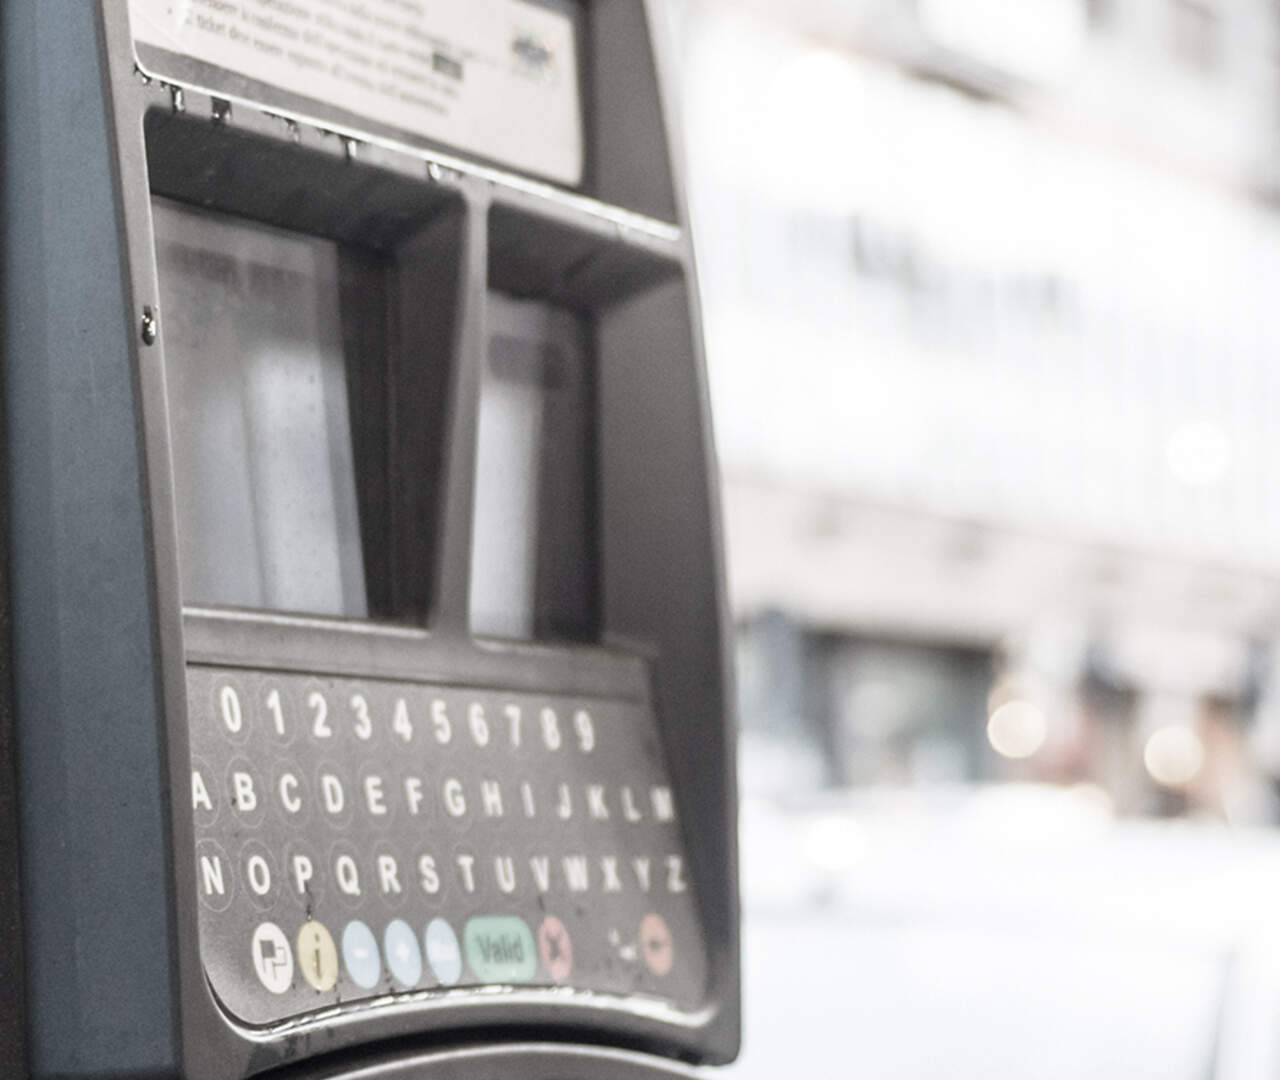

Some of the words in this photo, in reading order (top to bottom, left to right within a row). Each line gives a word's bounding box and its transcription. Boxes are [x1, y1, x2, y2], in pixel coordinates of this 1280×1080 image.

[222, 686, 242, 733] 0
[267, 689, 285, 735] 1
[308, 692, 333, 738] 2
[351, 694, 372, 740] 3
[392, 697, 413, 742] 4
[431, 699, 452, 744] 5
[468, 702, 490, 747] 6
[504, 704, 521, 748] 7
[539, 706, 561, 751] 8
[573, 709, 595, 752] 9
[192, 771, 213, 810] A
[233, 772, 257, 811] B
[279, 773, 302, 813] C
[322, 775, 344, 814] D
[365, 776, 387, 815] E
[405, 777, 424, 816] F
[444, 778, 467, 817] G
[481, 780, 504, 818] H
[522, 782, 536, 819] I
[557, 783, 572, 820] J
[587, 784, 610, 821] K
[621, 786, 642, 822] L
[200, 855, 225, 895] N
[248, 855, 270, 895] O
[293, 855, 312, 894] P
[336, 855, 361, 896] Q
[378, 855, 402, 894] R
[418, 855, 440, 894] S
[456, 855, 475, 893] T
[495, 855, 517, 893] U
[529, 855, 550, 893] V
[562, 855, 588, 893] W
[600, 855, 621, 893] X
[633, 856, 650, 892] Y
[665, 855, 687, 894] Z
[476, 933, 524, 966] Valid
